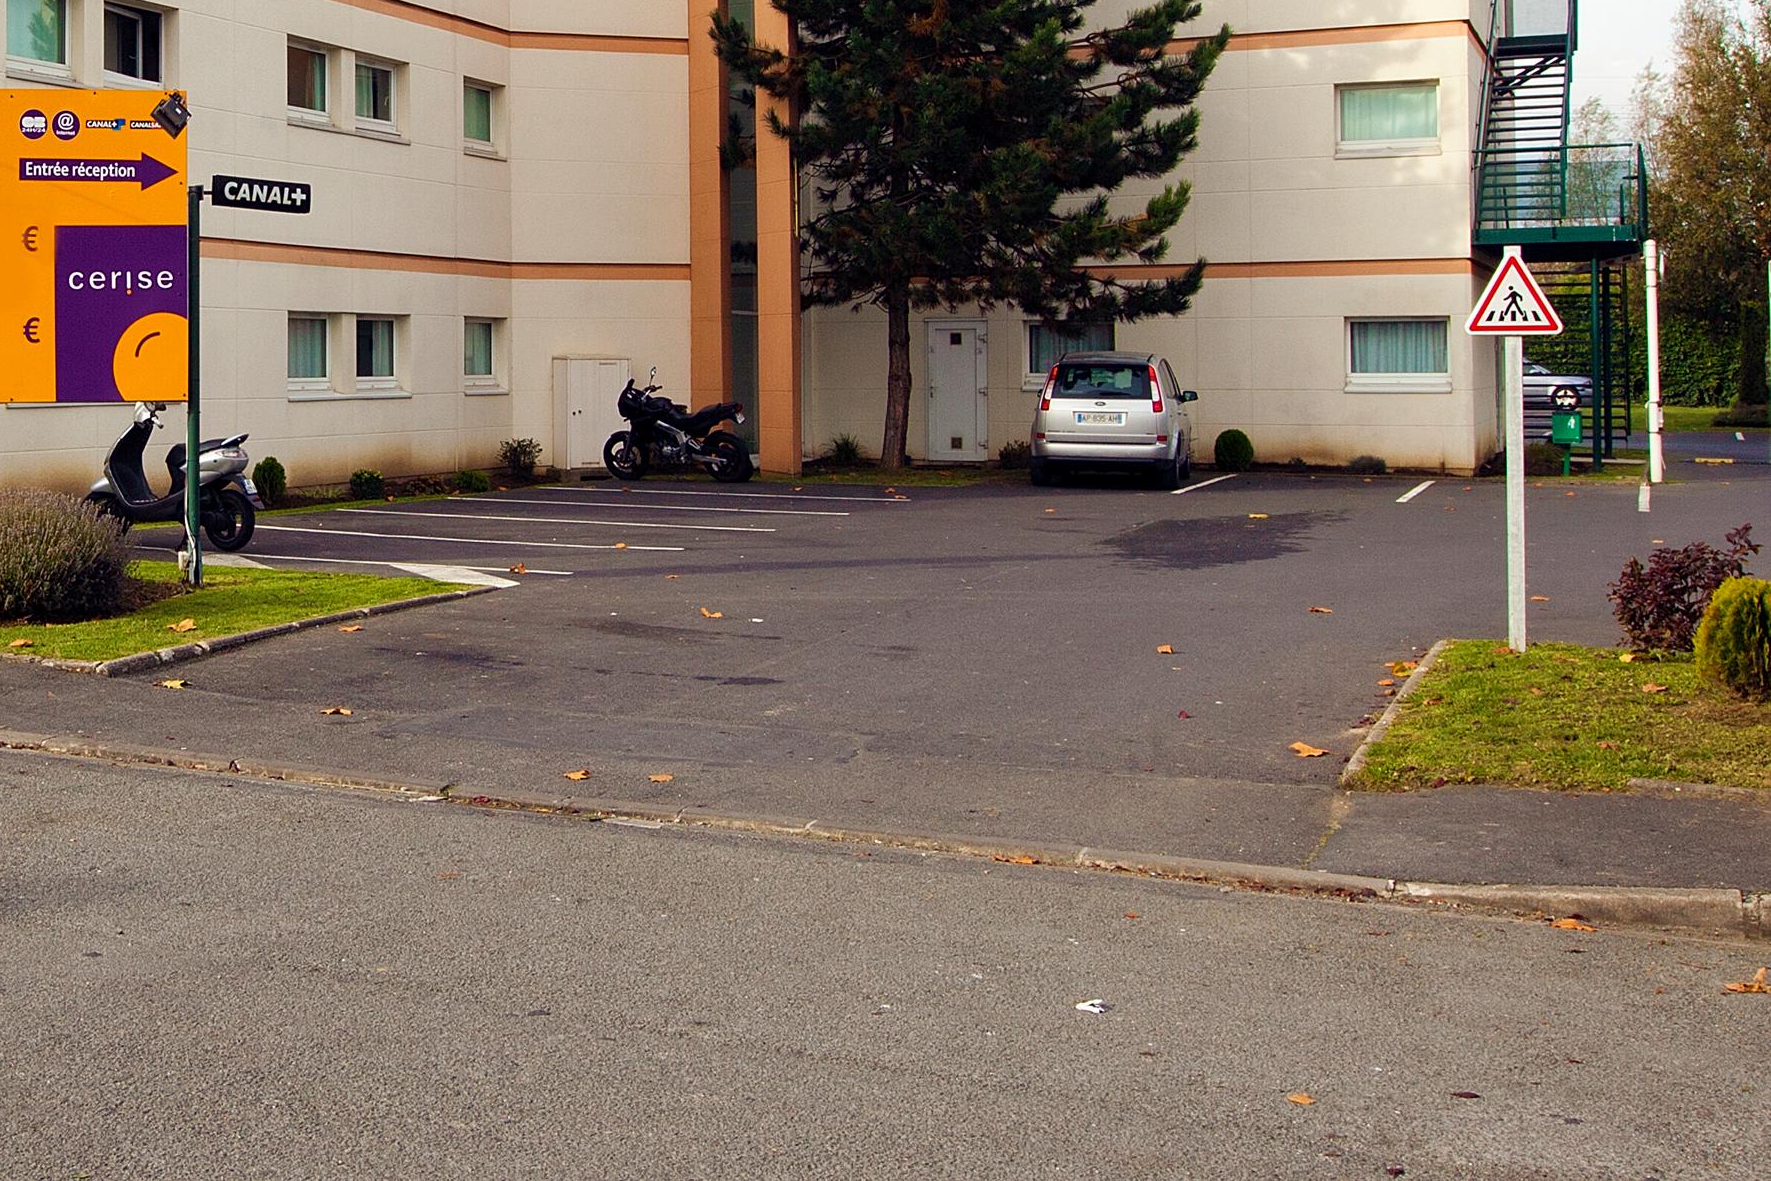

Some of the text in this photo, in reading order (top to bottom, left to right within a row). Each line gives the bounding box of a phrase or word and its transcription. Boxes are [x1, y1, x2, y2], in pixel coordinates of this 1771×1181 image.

[86, 120, 118, 128] CANAL+
[25, 161, 136, 181] Entrée réception
[224, 181, 307, 206] CANAL+
[68, 270, 174, 295] cerise
